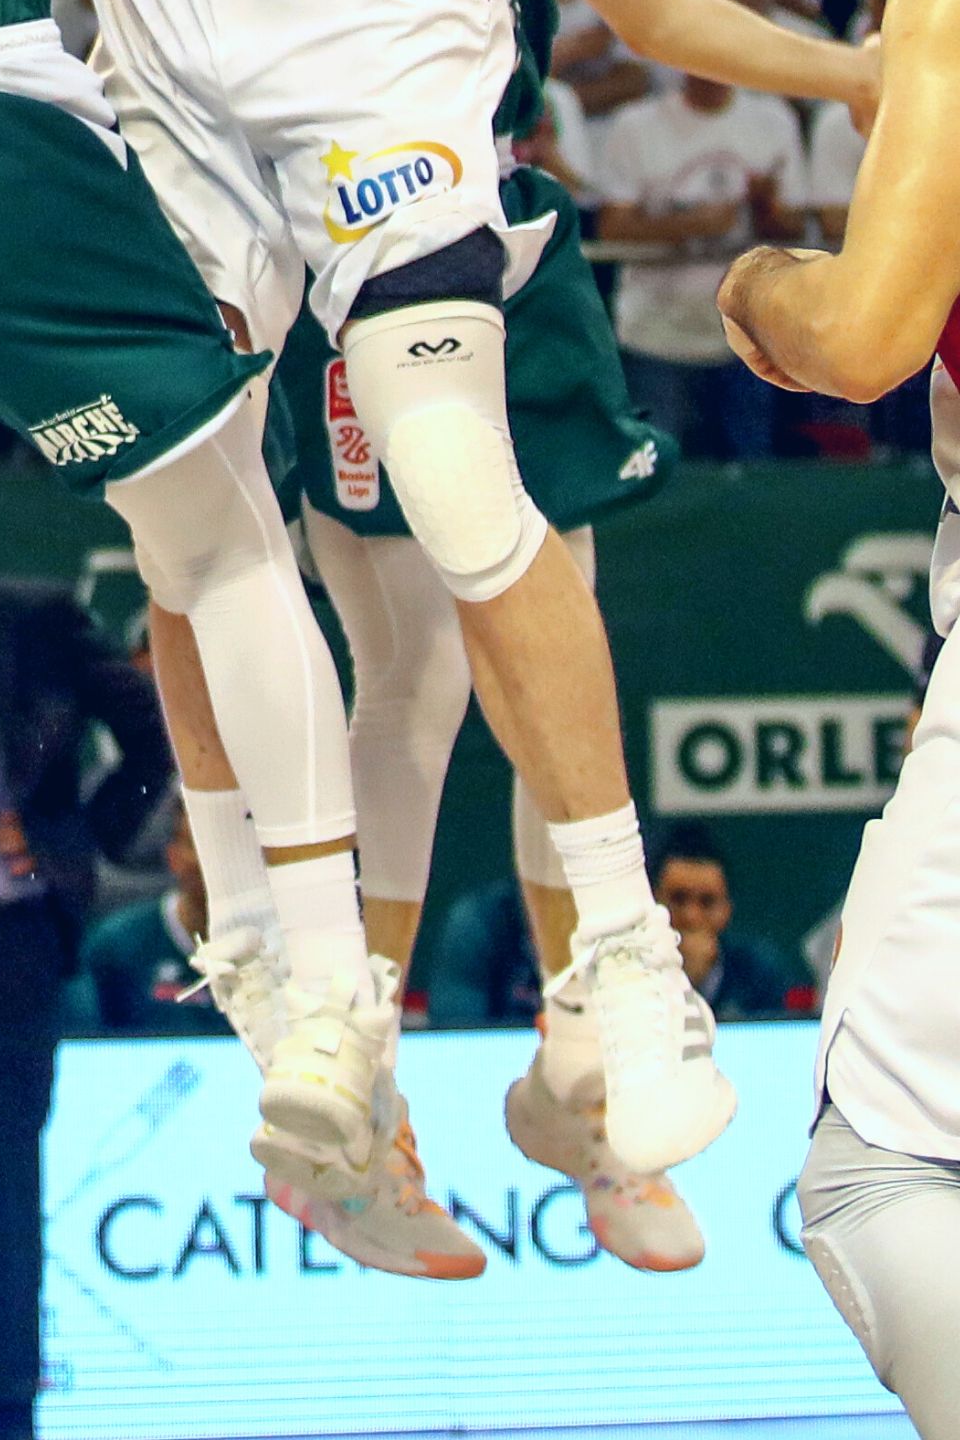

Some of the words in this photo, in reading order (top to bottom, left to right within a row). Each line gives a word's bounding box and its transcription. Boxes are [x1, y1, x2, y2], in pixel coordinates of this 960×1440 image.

[337, 157, 434, 225] LOTTO
[676, 715, 908, 793] ORLE
[96, 1184, 600, 1278] CATNG
